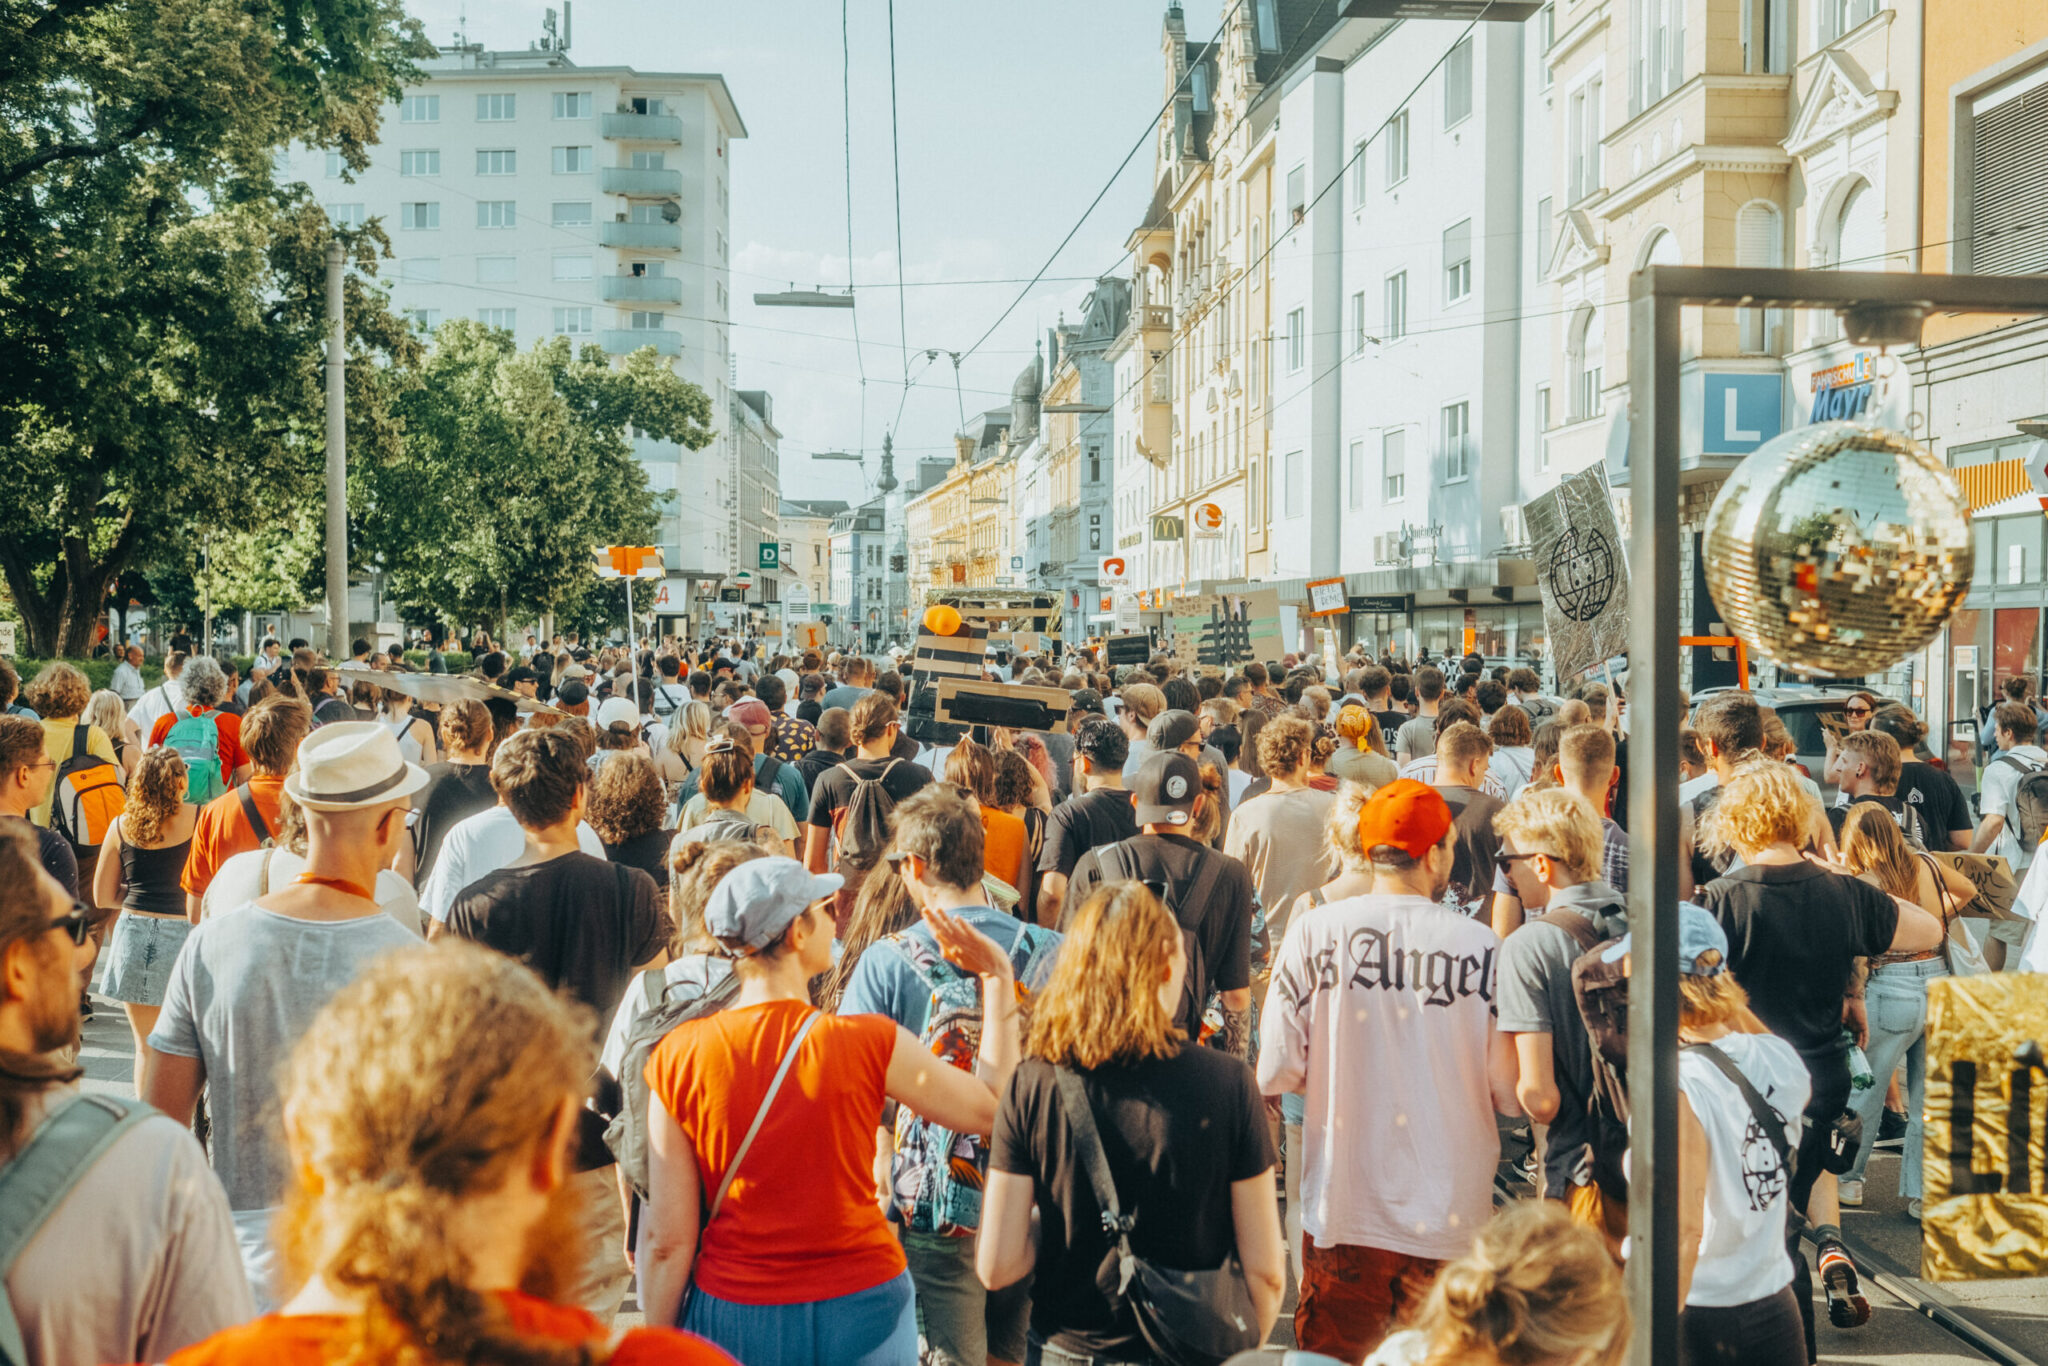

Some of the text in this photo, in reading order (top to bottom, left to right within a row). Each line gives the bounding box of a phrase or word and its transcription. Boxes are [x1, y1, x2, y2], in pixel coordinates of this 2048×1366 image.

[1812, 353, 1871, 391] FAHRSCHULE
[1725, 388, 1761, 441] L
[1808, 383, 1872, 425] Mayr
[655, 585, 670, 604] A
[1100, 578, 1129, 586] ruefa
[1349, 926, 1498, 1017] Angel
